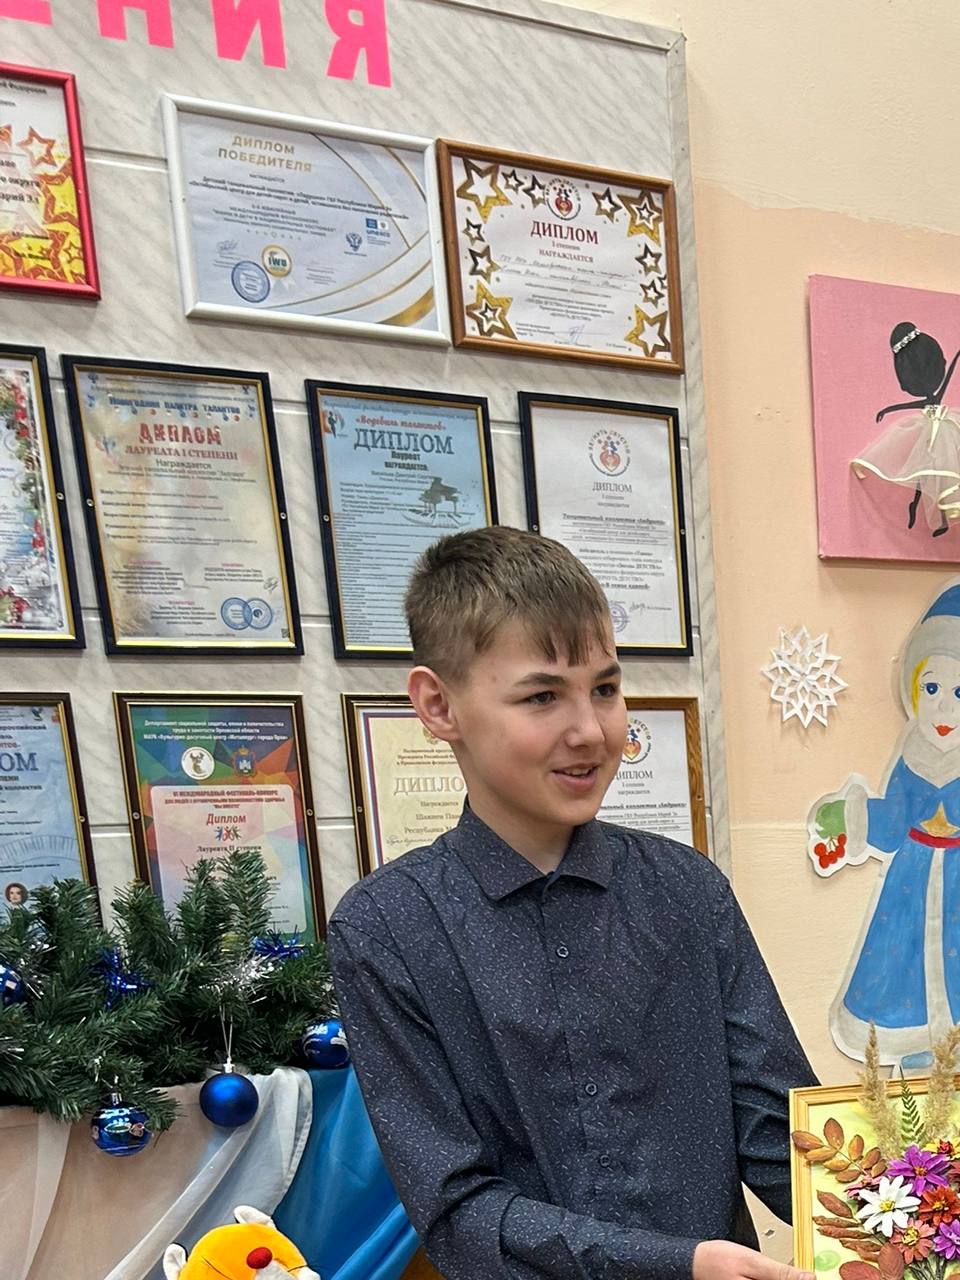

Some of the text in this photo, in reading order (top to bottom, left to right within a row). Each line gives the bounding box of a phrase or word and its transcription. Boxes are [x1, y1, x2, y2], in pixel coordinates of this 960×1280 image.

[0, 0, 392, 89] НИЯ
[231, 135, 296, 155] ДИПЛОМ
[217, 147, 313, 173] ПОБЕДИТЕЛЯ
[530, 220, 600, 245] ДИПЛОМ
[138, 423, 223, 446] ДИПЛОМ
[354, 428, 455, 455] ДИПЛОМ
[125, 445, 181, 457] ЛАУРЕАТА
[188, 450, 238, 461] СТЕПЕНИ
[592, 482, 632, 492] ДИПЛОМ
[393, 776, 465, 795] ДИПЛО
[206, 813, 247, 826] Диплом
